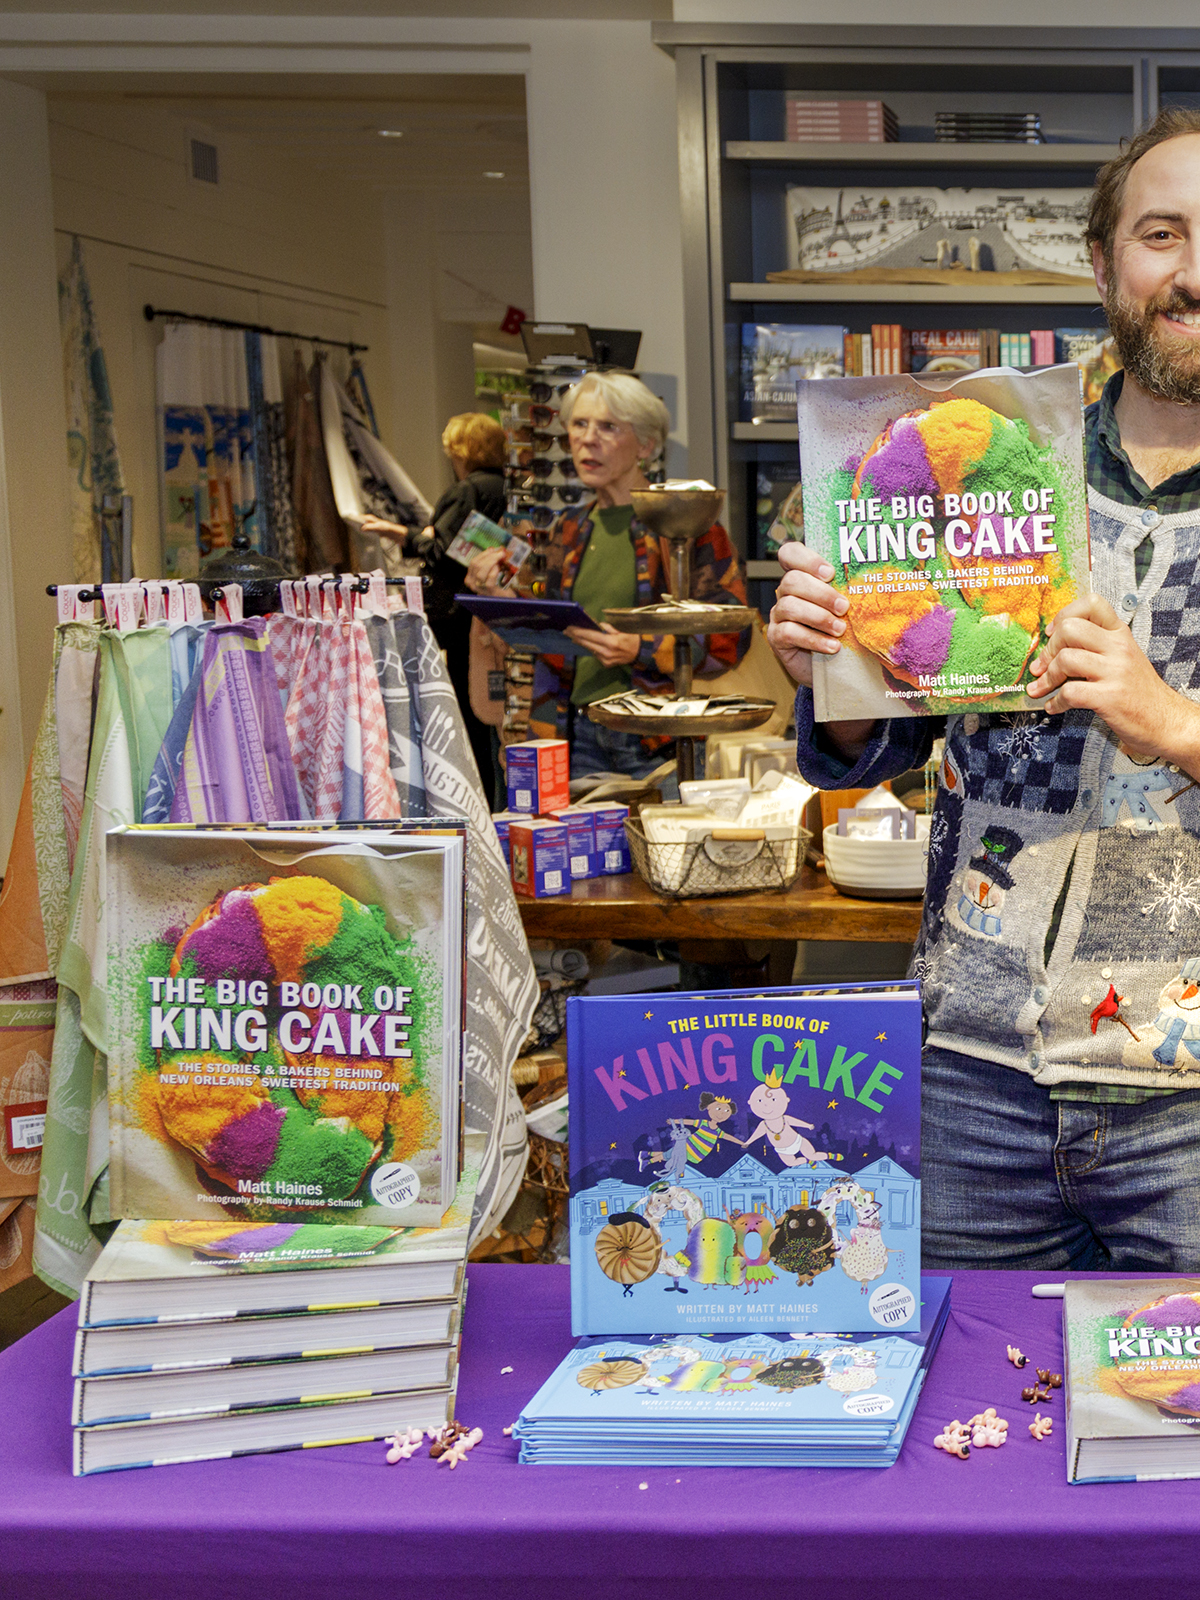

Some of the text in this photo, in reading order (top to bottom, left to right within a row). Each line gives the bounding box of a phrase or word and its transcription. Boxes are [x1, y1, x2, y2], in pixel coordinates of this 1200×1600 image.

[912, 331, 941, 346] REAL
[1062, 341, 1096, 349] DOWN
[1062, 350, 1096, 358] SOUTH
[836, 488, 1054, 522] THE BIG BOOK OF
[839, 515, 1058, 563] KING CAKE
[863, 565, 1034, 582] THE STORIES & BAKERS BEHIND
[849, 585, 873, 594] NEW
[933, 579, 988, 590] SWEETEST
[992, 576, 1049, 587] TRADITION
[919, 673, 990, 687] Matt Haines
[885, 684, 1024, 700] Photography by Randy Krause Schmidt
[148, 977, 412, 1012] THE BIG BOOK OF
[668, 1013, 829, 1034] THE LITTLE BOOK OF
[150, 1007, 412, 1058] KING CAKE
[178, 1063, 383, 1078] THE STORIES & BAKERS BEHIND
[594, 1033, 904, 1113] KING CAKE
[160, 1074, 189, 1084] NEW
[262, 1077, 328, 1089] SWEETEST
[333, 1080, 399, 1091] TRADITION
[238, 1179, 322, 1195] Matt Haines
[197, 1194, 362, 1207] Photography by Randy Krause Schmidt
[388, 1186, 414, 1206] COPY
[239, 1247, 332, 1259] Matt Haines
[677, 1304, 818, 1314] WRITTEN BY MATT HAINES
[872, 1295, 912, 1315] AUTOGRAPHED
[883, 1306, 908, 1324] COPY
[1104, 1327, 1156, 1339] THE
